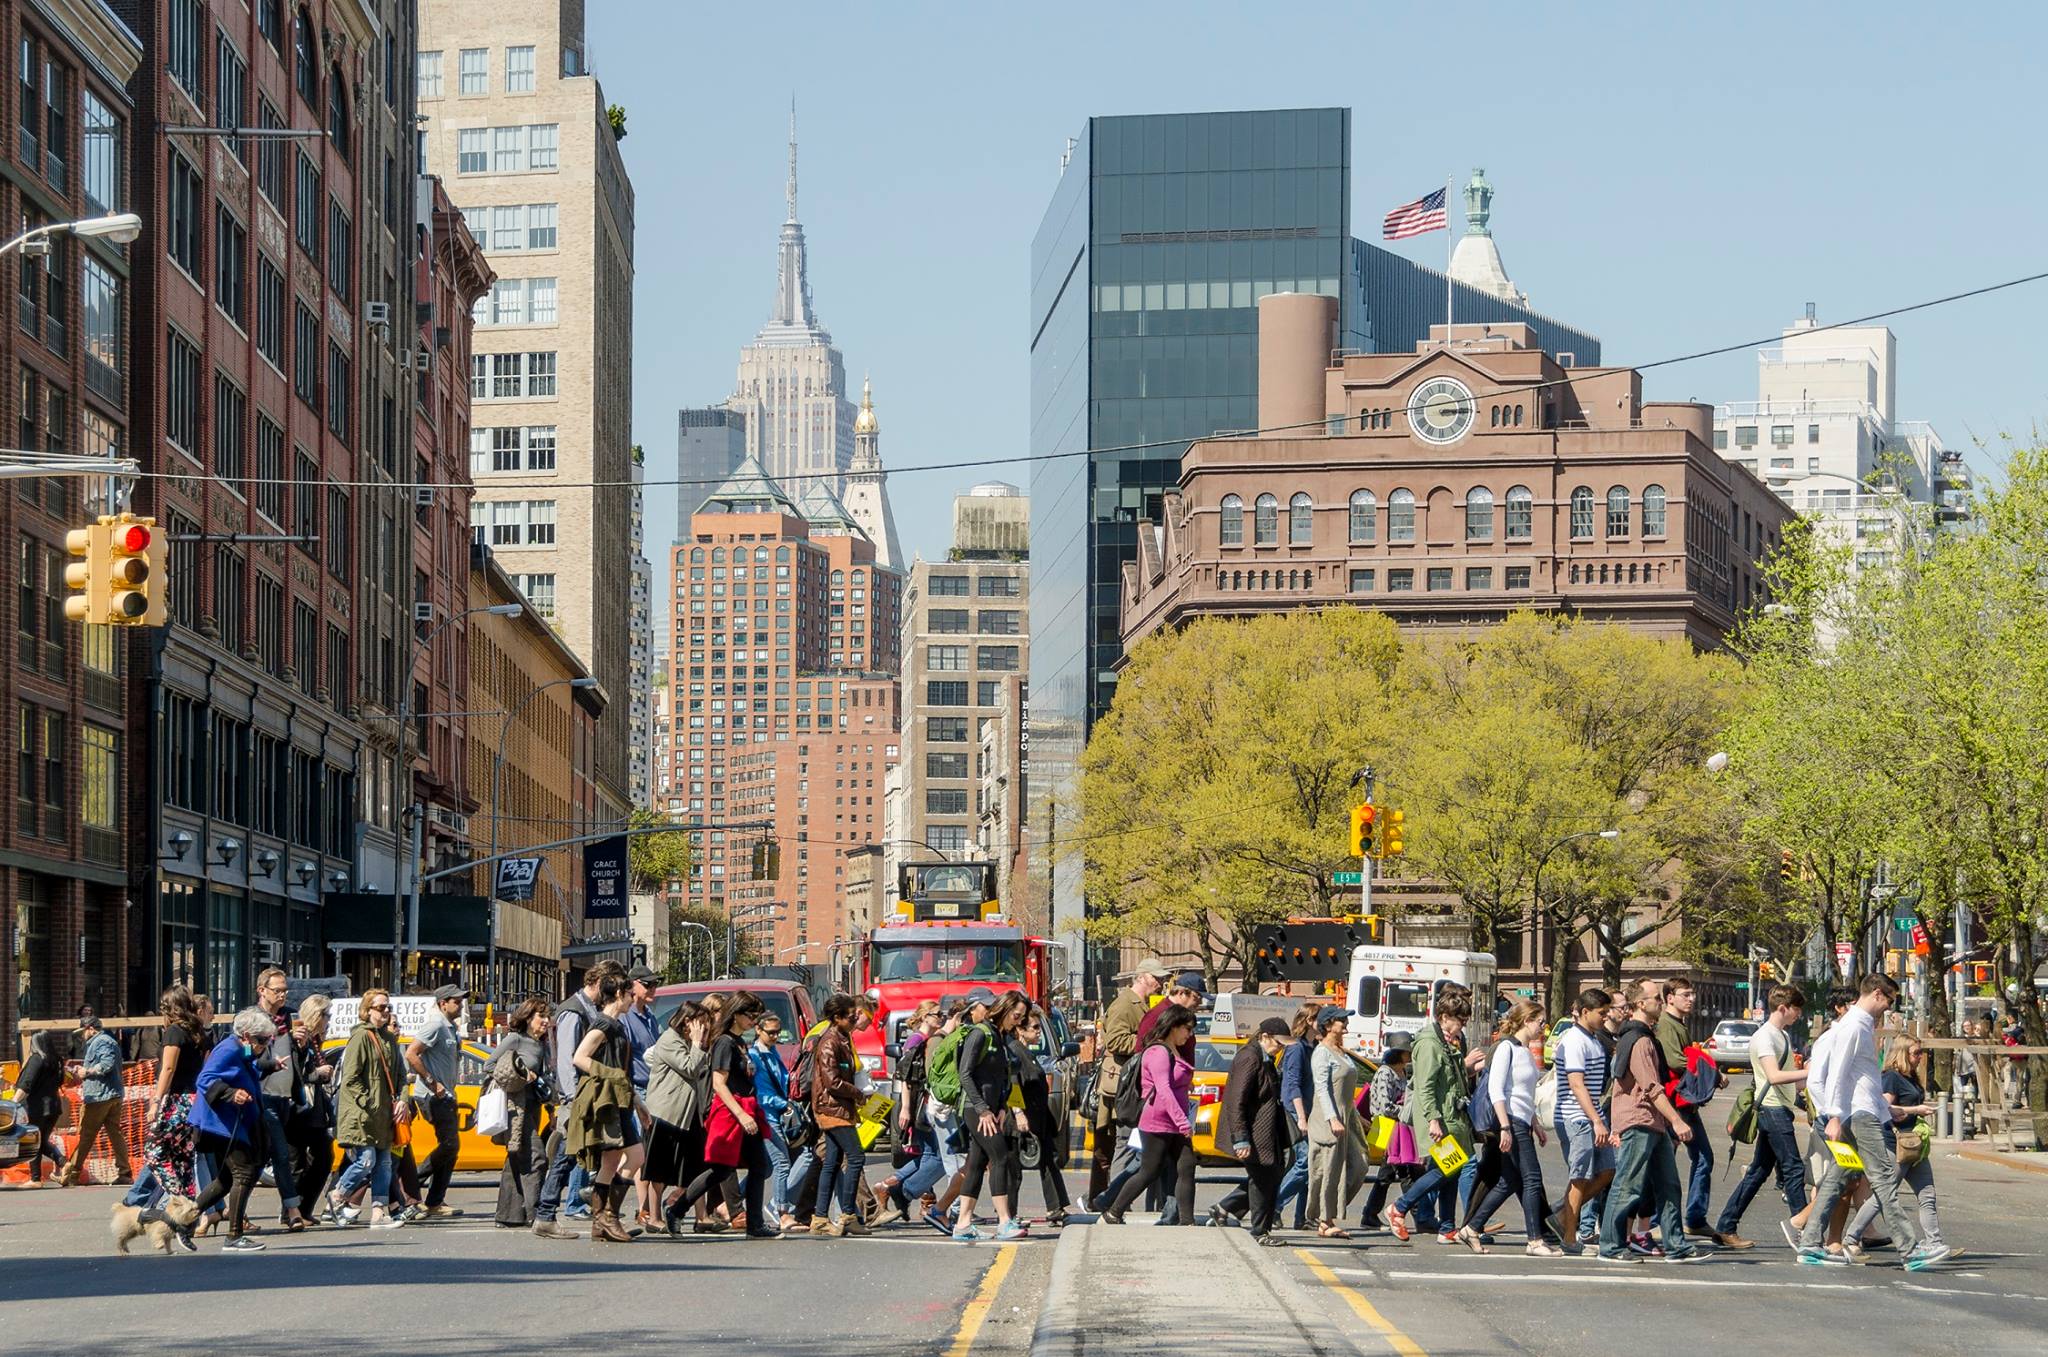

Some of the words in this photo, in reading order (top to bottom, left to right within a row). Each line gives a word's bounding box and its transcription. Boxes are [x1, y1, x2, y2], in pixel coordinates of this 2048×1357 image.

[593, 860, 617, 869] GRACE
[591, 869, 620, 878] CHURCH
[591, 898, 620, 907] SCHOOL
[937, 959, 963, 969] DEP
[396, 1002, 427, 1014] EYES
